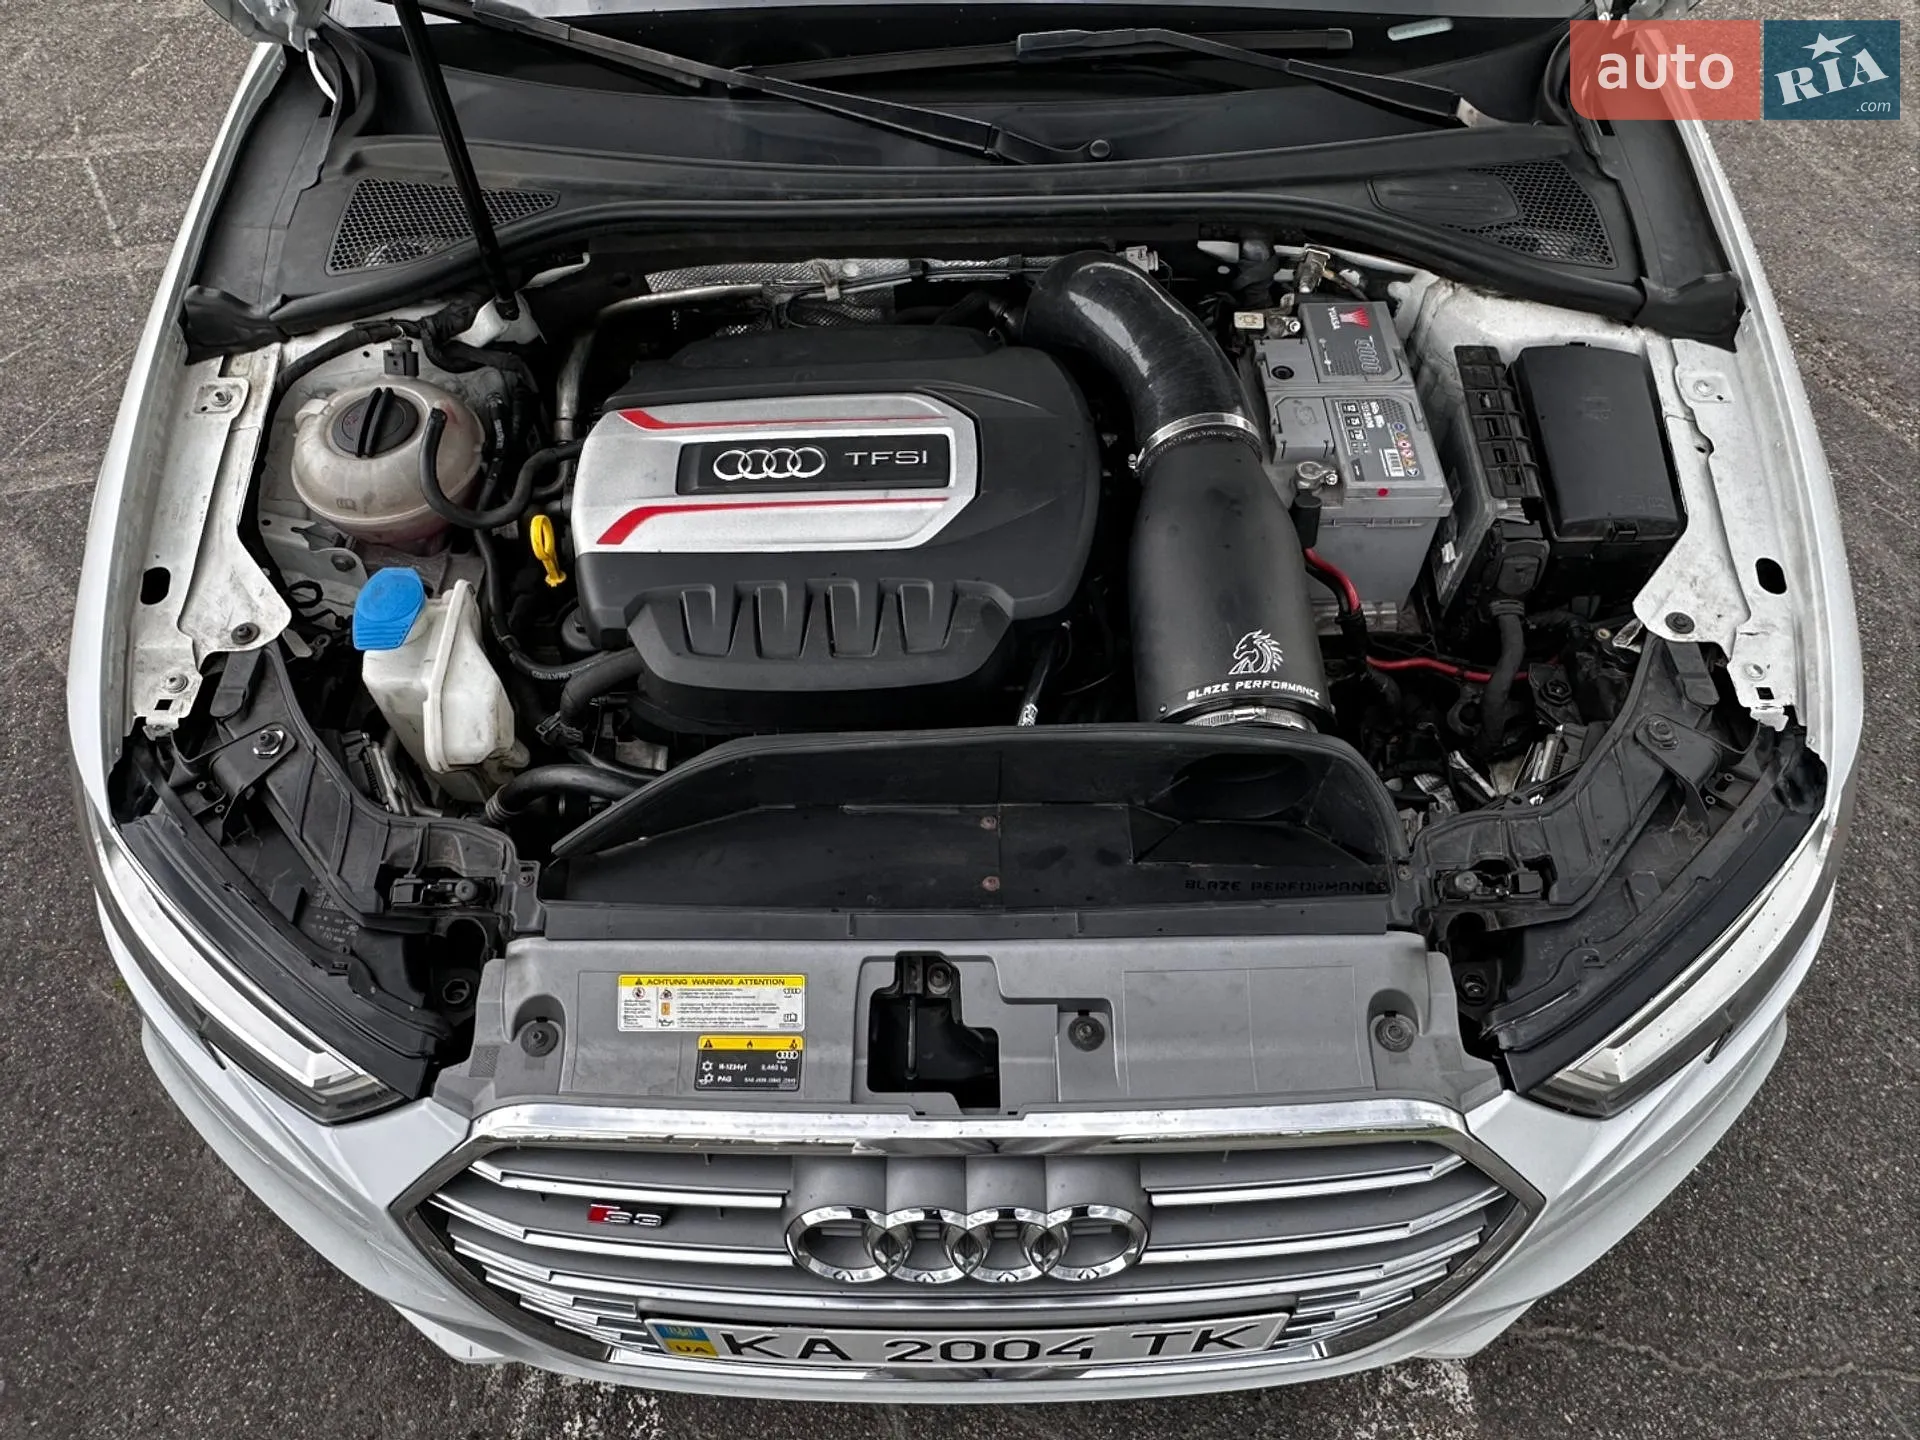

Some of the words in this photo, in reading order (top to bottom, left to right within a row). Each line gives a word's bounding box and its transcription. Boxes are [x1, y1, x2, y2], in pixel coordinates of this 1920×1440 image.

[845, 450, 929, 466] TFSI
[1186, 682, 1230, 700] BLAZE
[1235, 679, 1321, 700] PERFORMANCE
[1184, 879, 1242, 893] BLAZE
[646, 978, 688, 986] ACHTUNG
[692, 978, 734, 986] WARNING
[738, 978, 786, 986] ATTENTION
[717, 1075, 732, 1083] PAG
[602, 1210, 662, 1227] S3
[720, 1332, 853, 1362] KA
[884, 1335, 1096, 1362] 2004
[1131, 1323, 1261, 1356] TK
